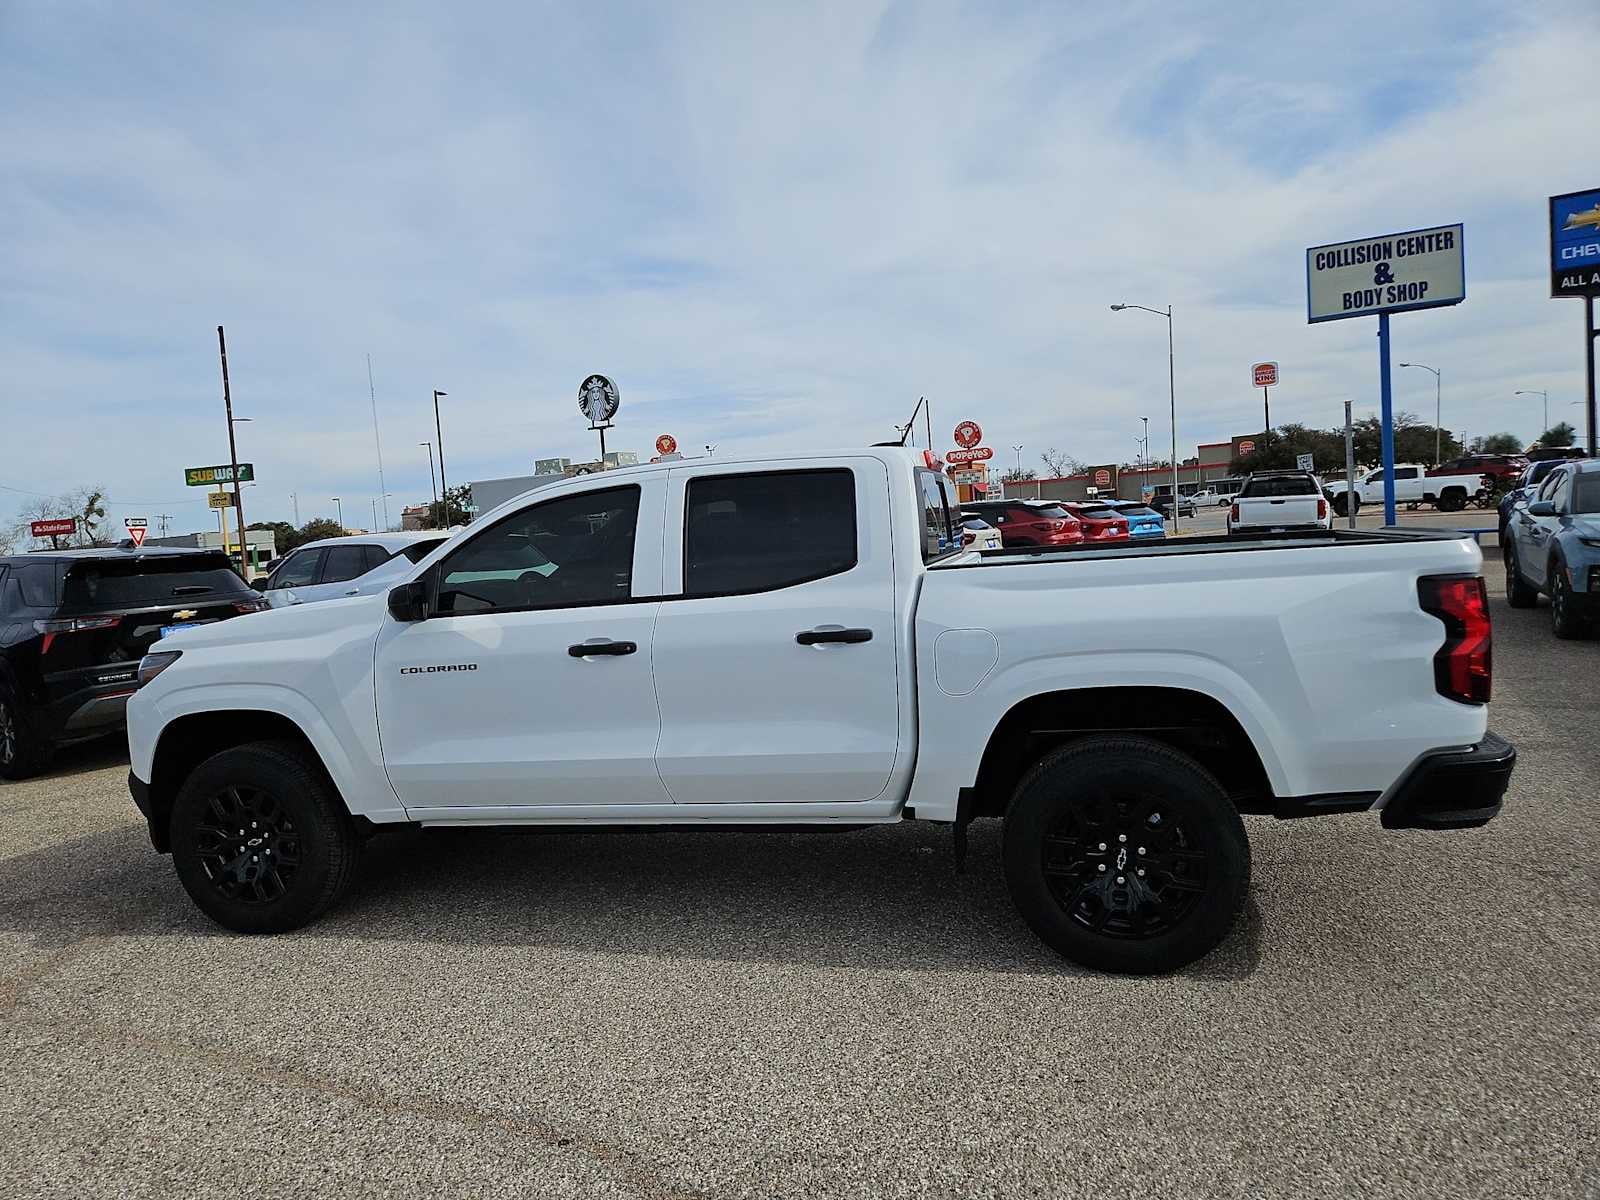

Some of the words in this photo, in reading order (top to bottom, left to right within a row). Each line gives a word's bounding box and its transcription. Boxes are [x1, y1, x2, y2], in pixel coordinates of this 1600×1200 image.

[1315, 241, 1392, 271] COLLISION
[1396, 231, 1454, 258] CENTER
[1374, 262, 1395, 285] &
[1561, 275, 1587, 288] ALL
[1342, 287, 1384, 311] BODY
[1387, 281, 1429, 304] SHOP
[1255, 375, 1276, 383] KING
[400, 664, 478, 674] COLORADO
